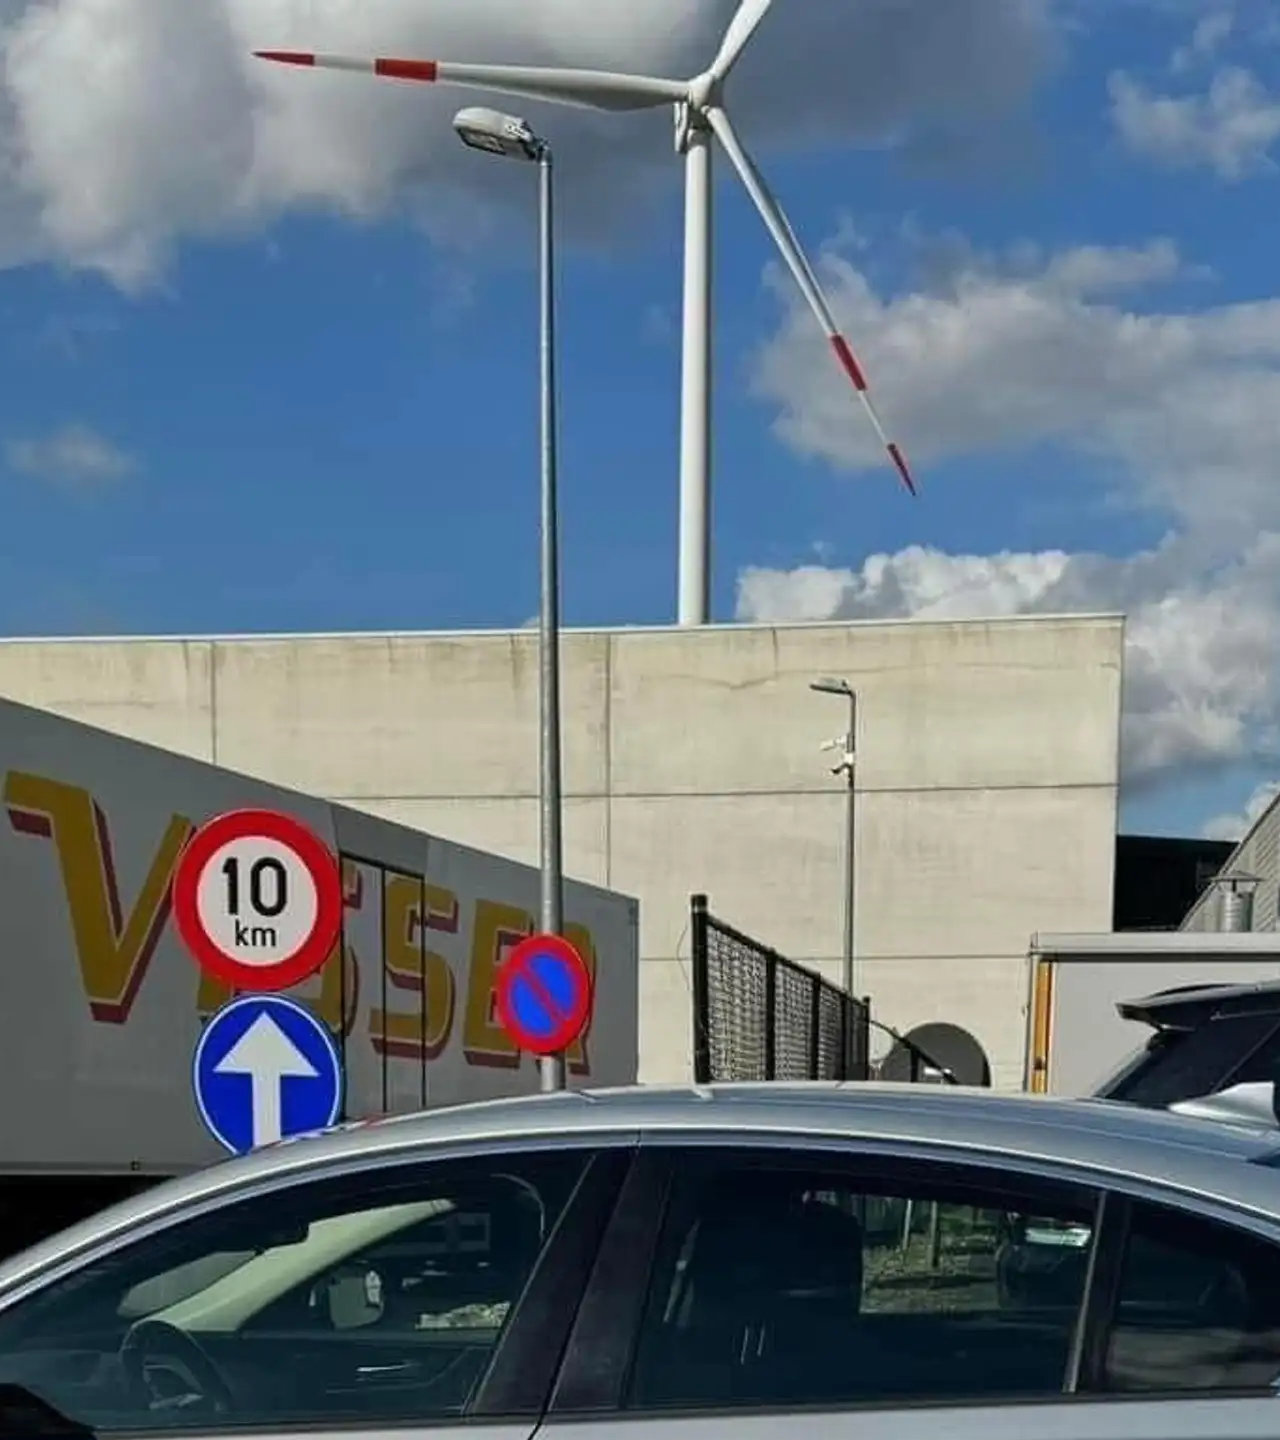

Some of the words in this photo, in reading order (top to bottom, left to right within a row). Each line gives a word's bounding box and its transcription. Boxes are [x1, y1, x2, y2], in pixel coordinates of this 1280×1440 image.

[222, 857, 287, 917] 10
[3, 770, 597, 1076] VSE
[235, 919, 276, 947] km
